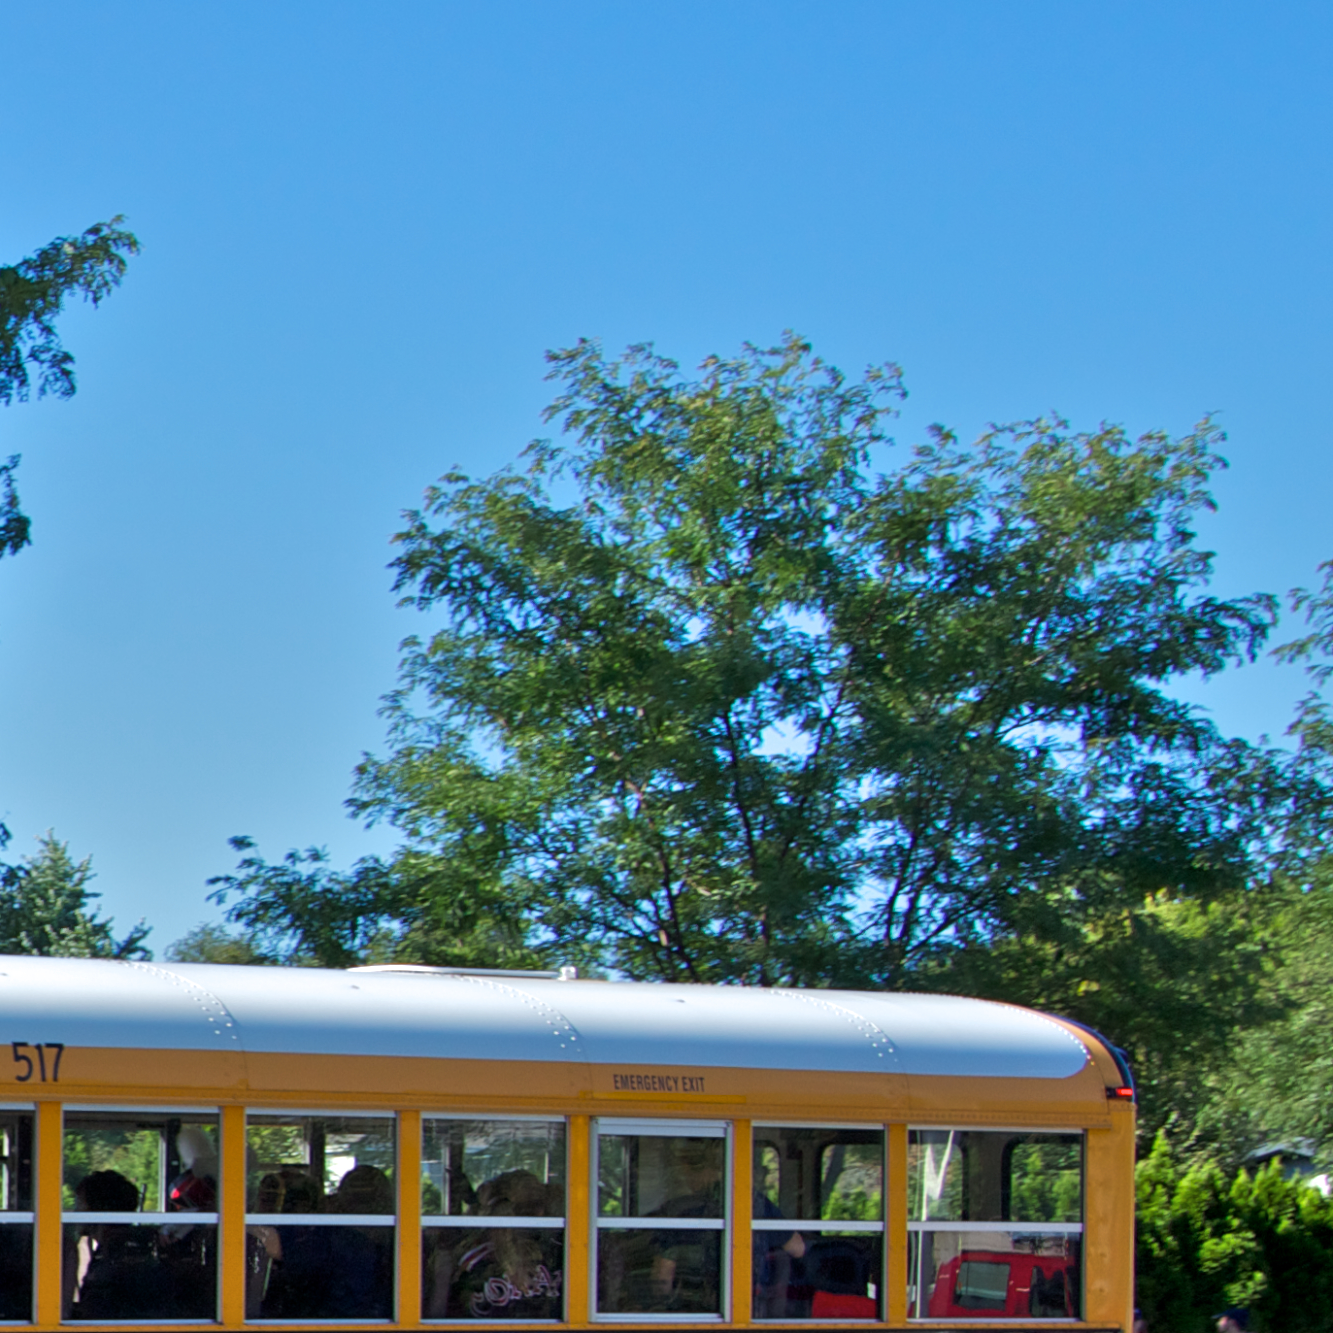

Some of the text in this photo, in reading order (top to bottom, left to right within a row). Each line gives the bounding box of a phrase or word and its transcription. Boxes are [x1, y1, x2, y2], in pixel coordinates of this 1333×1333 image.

[12, 1041, 65, 1083] 517
[613, 1073, 705, 1093] EMERGENCY EXIT
